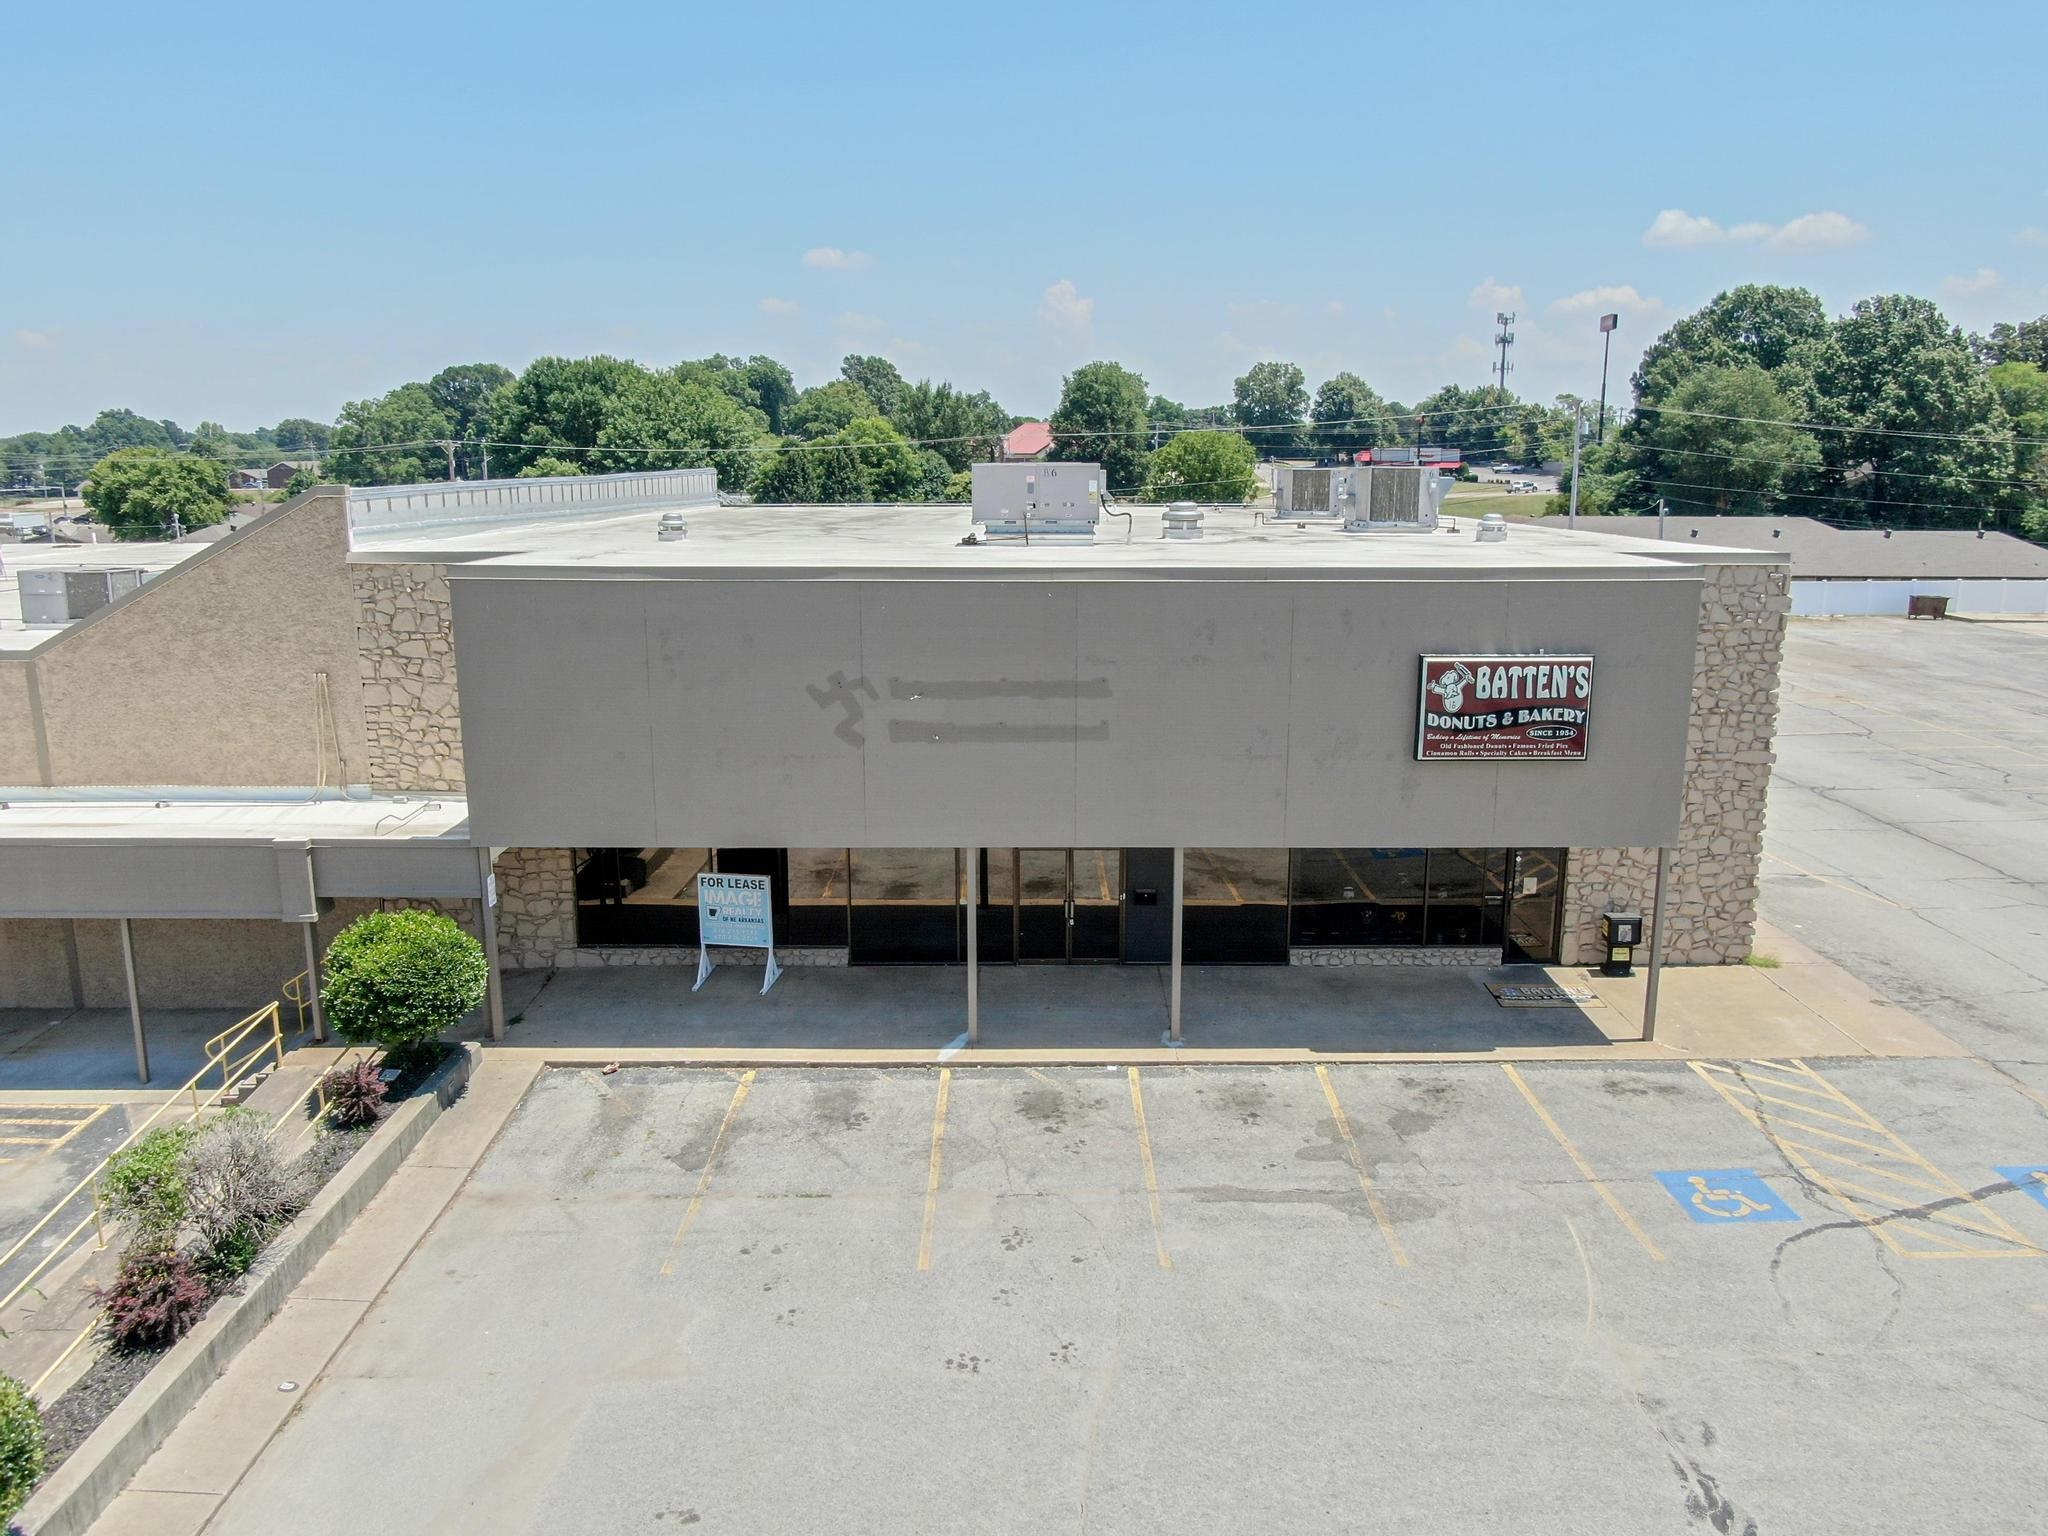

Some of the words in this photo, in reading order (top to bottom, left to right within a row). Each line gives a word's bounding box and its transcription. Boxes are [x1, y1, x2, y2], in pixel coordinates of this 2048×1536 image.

[1475, 665, 1589, 699] BATTEN'S
[1427, 713, 1497, 730] DONUTS
[1502, 712, 1514, 726] &
[1517, 707, 1586, 724] BAKERY
[1426, 733, 1448, 742] Baking
[1455, 733, 1482, 742] Lifetime
[1482, 734, 1490, 742] of
[1490, 733, 1521, 741] Memories
[701, 878, 724, 888] FOR
[728, 879, 765, 890] LEASE
[704, 890, 762, 906] IMAGE
